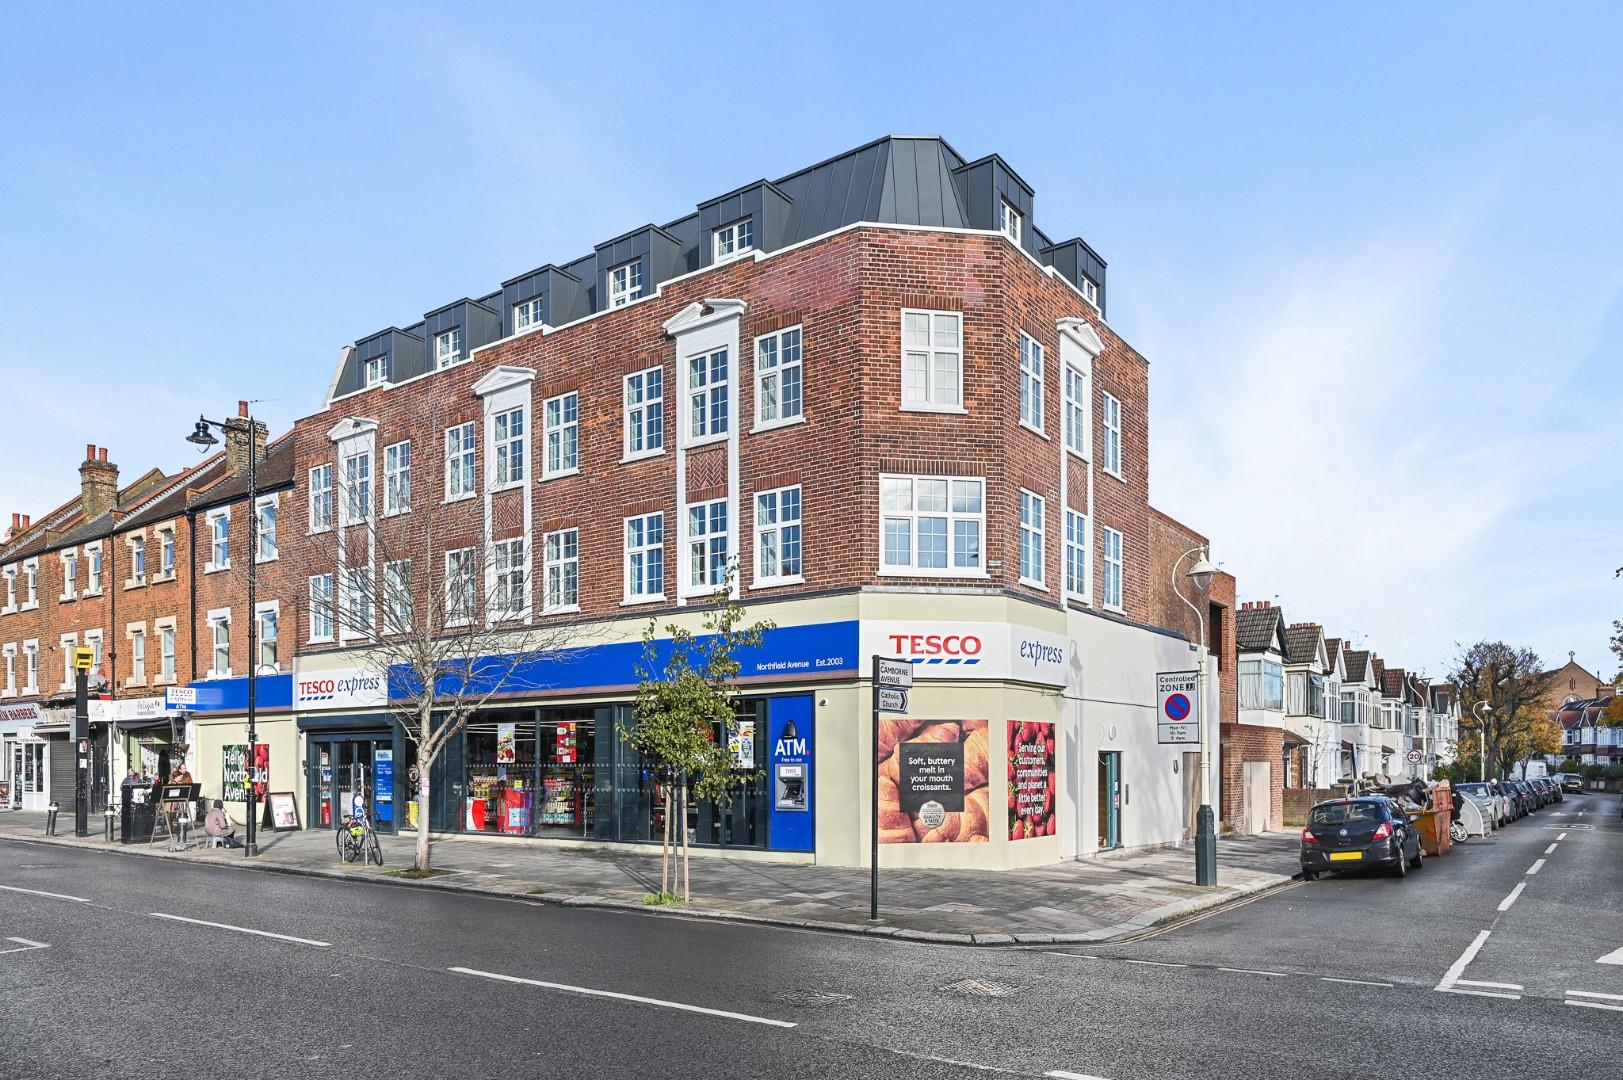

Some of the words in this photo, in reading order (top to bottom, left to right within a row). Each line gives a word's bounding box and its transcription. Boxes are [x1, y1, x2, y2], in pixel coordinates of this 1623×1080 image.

[889, 635, 982, 655] TESCO
[1020, 640, 1063, 667] express
[757, 661, 786, 671] Northfield
[787, 661, 810, 669] Avenue
[815, 657, 844, 667] Est.2003
[880, 665, 909, 677] CAMBORNE
[880, 675, 901, 685] AVENUE
[1160, 675, 1195, 683] Controlled
[299, 680, 335, 695] TESCO
[337, 676, 380, 697] express
[1160, 683, 1185, 692] ZONE
[881, 691, 900, 700] Catholic
[883, 700, 899, 708] Church
[1018, 742, 1037, 755] Serving
[1037, 745, 1046, 753] our
[224, 751, 245, 765] Hello
[908, 757, 926, 766] Soft,
[927, 757, 956, 767] buttery
[1018, 757, 1045, 766] customers,
[919, 766, 936, 774] melt
[1017, 768, 1048, 777] communities
[910, 775, 928, 784] your
[929, 773, 953, 782] mouth
[912, 783, 952, 791] croissants.
[1017, 780, 1028, 789] and
[1028, 780, 1042, 791] planet
[1018, 793, 1030, 803] little
[1030, 793, 1046, 803] better
[1020, 807, 1034, 816] every
